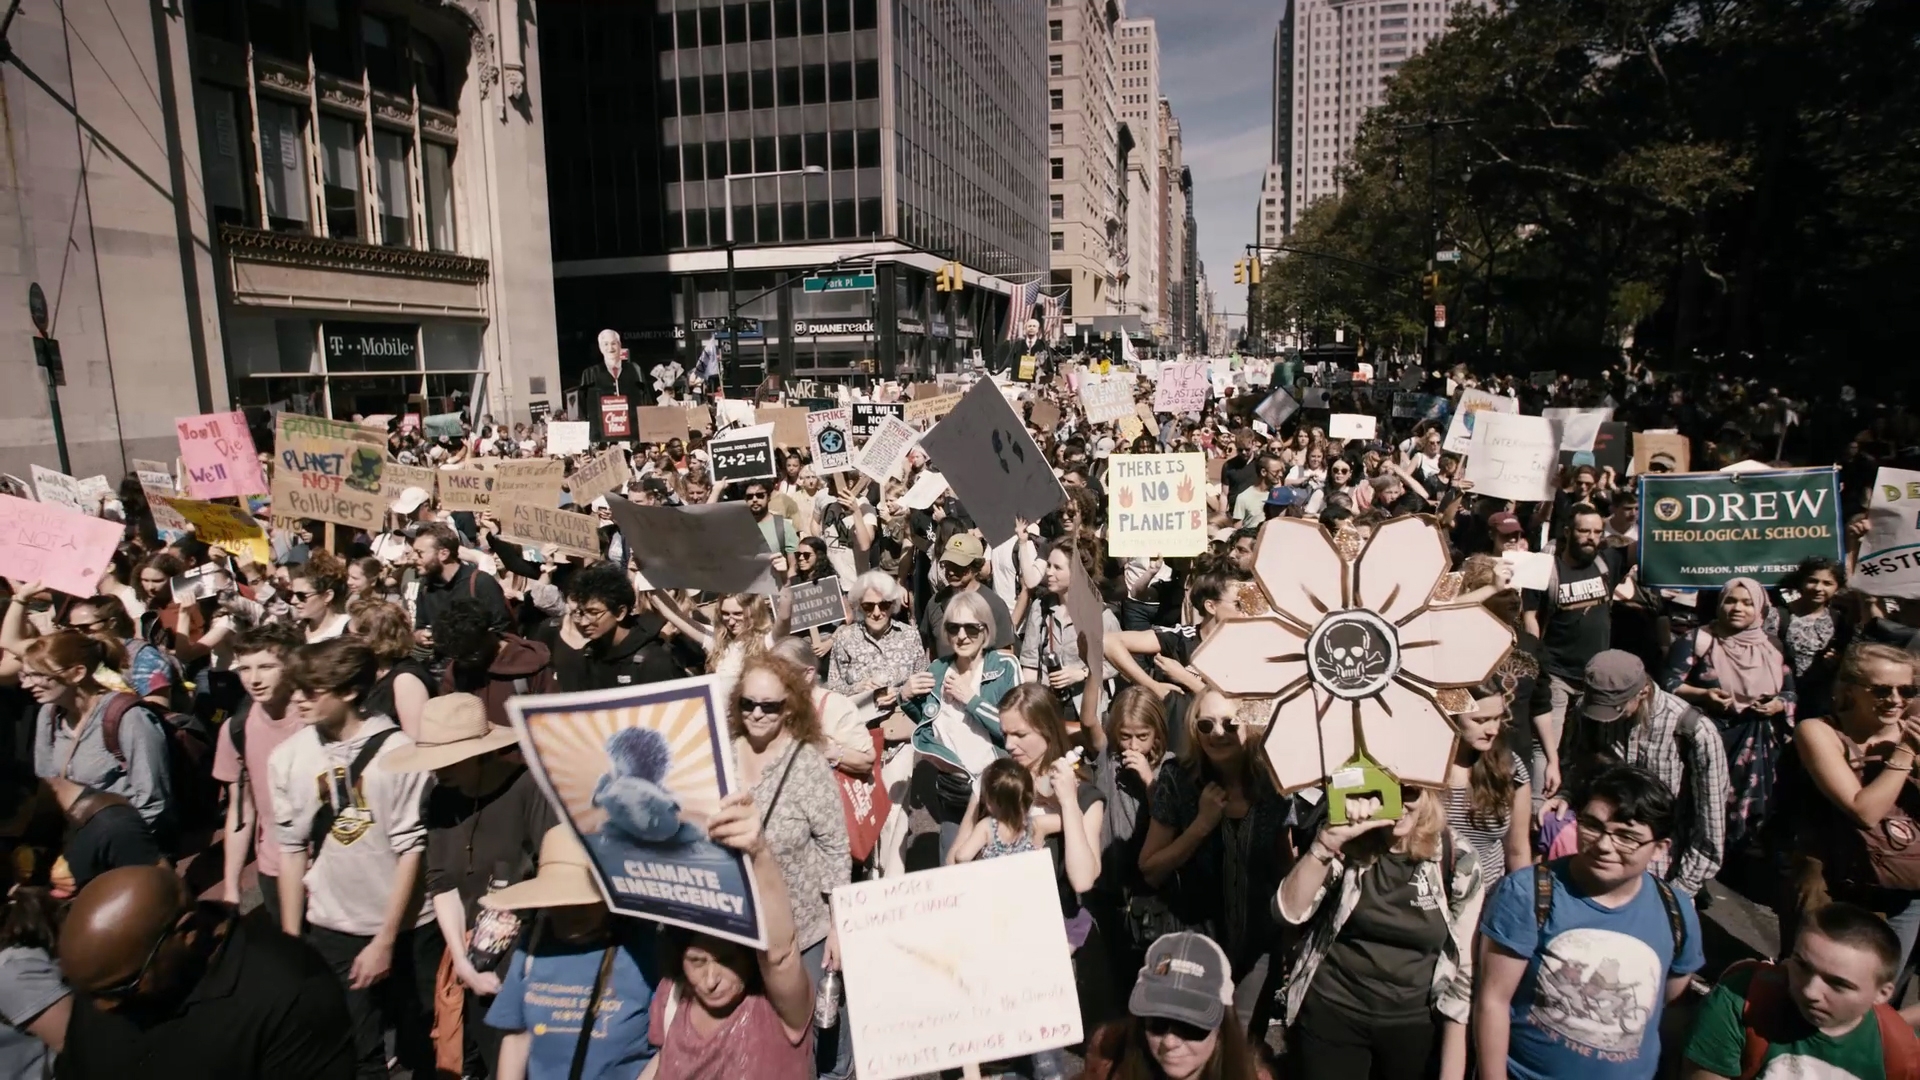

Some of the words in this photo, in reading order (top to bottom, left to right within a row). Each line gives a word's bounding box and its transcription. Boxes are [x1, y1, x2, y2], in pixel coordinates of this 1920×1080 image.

[693, 320, 708, 330] Park
[1163, 363, 1204, 383] FUCK
[785, 380, 818, 399] WAKE
[1161, 388, 1204, 400] PLASTICS
[807, 409, 846, 423] STRIKE
[857, 405, 873, 414] WE
[875, 405, 899, 415] WILL
[1088, 402, 1135, 423] URANUS
[178, 420, 222, 440] You'll
[853, 425, 866, 434] BE
[886, 420, 912, 441] STRIKE
[214, 438, 243, 457] Die
[282, 449, 345, 476] PLANET
[717, 450, 766, 468] 2+2=4
[1117, 461, 1161, 477] THERE
[1166, 460, 1185, 474] IS
[189, 463, 227, 483] We'll
[302, 472, 343, 494] NOT
[448, 475, 480, 490] MAKE
[570, 462, 601, 489] THERE
[599, 457, 607, 473] IS
[1141, 481, 1169, 502] NO
[289, 490, 374, 522] Polluters
[1686, 488, 1829, 523] DREW
[514, 503, 530, 521] AS
[534, 506, 552, 527] THE
[554, 512, 591, 535] OCEANS
[1119, 511, 1185, 532] PLANET
[17, 527, 63, 552] NOT
[539, 523, 552, 542] SO
[552, 529, 575, 548] WILL
[576, 534, 592, 550] WE
[1652, 528, 1761, 543] THEOLOGICAL
[1765, 525, 1831, 540] SCHOOL
[1734, 564, 1759, 574] NEW
[1761, 564, 1801, 574] JERSEY
[803, 585, 823, 597] TOO
[824, 594, 838, 604] TO
[802, 607, 834, 623] FUNNY
[624, 859, 721, 891] CLIMATE
[612, 876, 744, 915] EMERGENCY
[839, 889, 867, 911] NO
[883, 878, 934, 899] MORE
[842, 905, 906, 934] CLIMATE
[913, 893, 966, 915] CHANGE
[867, 1046, 938, 1076] CLIMATE
[948, 1031, 1006, 1058] CHANGE
[1018, 1030, 1033, 1044] IS
[1039, 1023, 1072, 1041] BAD
